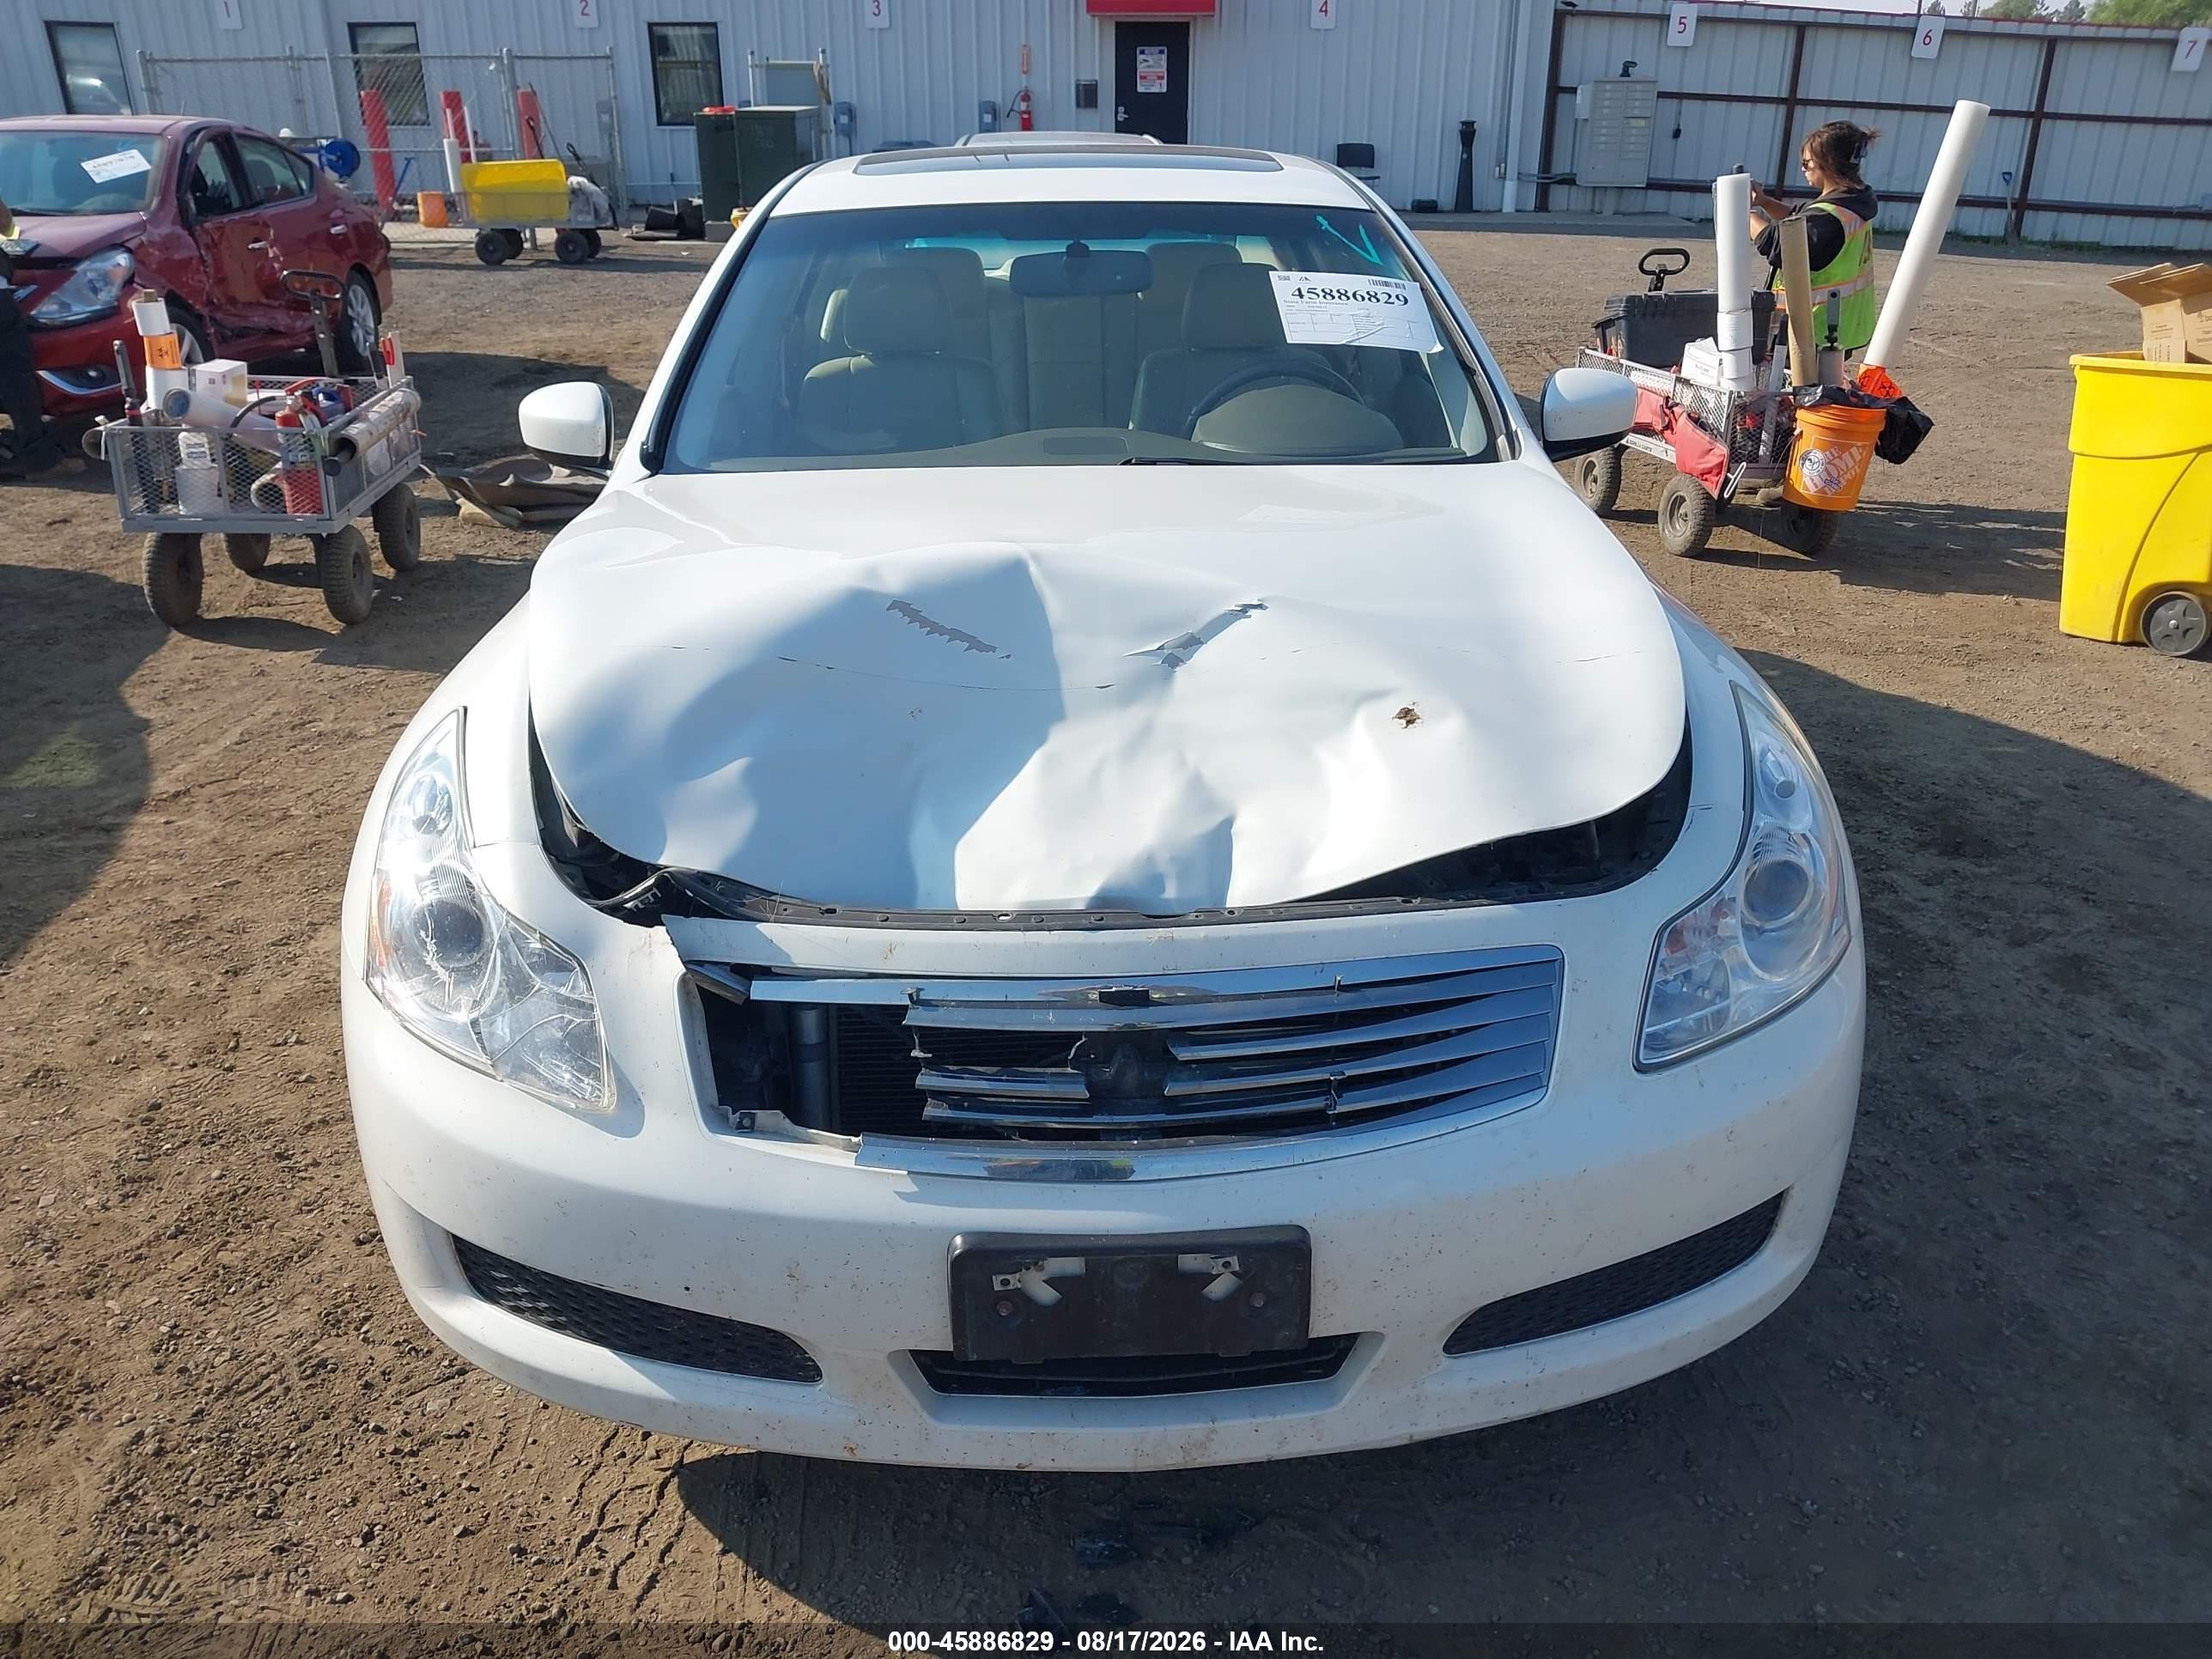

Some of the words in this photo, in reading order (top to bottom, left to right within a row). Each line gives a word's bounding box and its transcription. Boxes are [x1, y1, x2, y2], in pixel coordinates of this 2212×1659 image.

[224, 0, 231, 18] 1
[580, 0, 591, 17] 2
[872, 0, 882, 17] 3
[1318, 0, 1328, 17] 4
[1677, 15, 1688, 34] 5
[1923, 28, 1933, 46] 6
[2185, 40, 2198, 59] 7
[1291, 286, 1409, 307] 45886829
